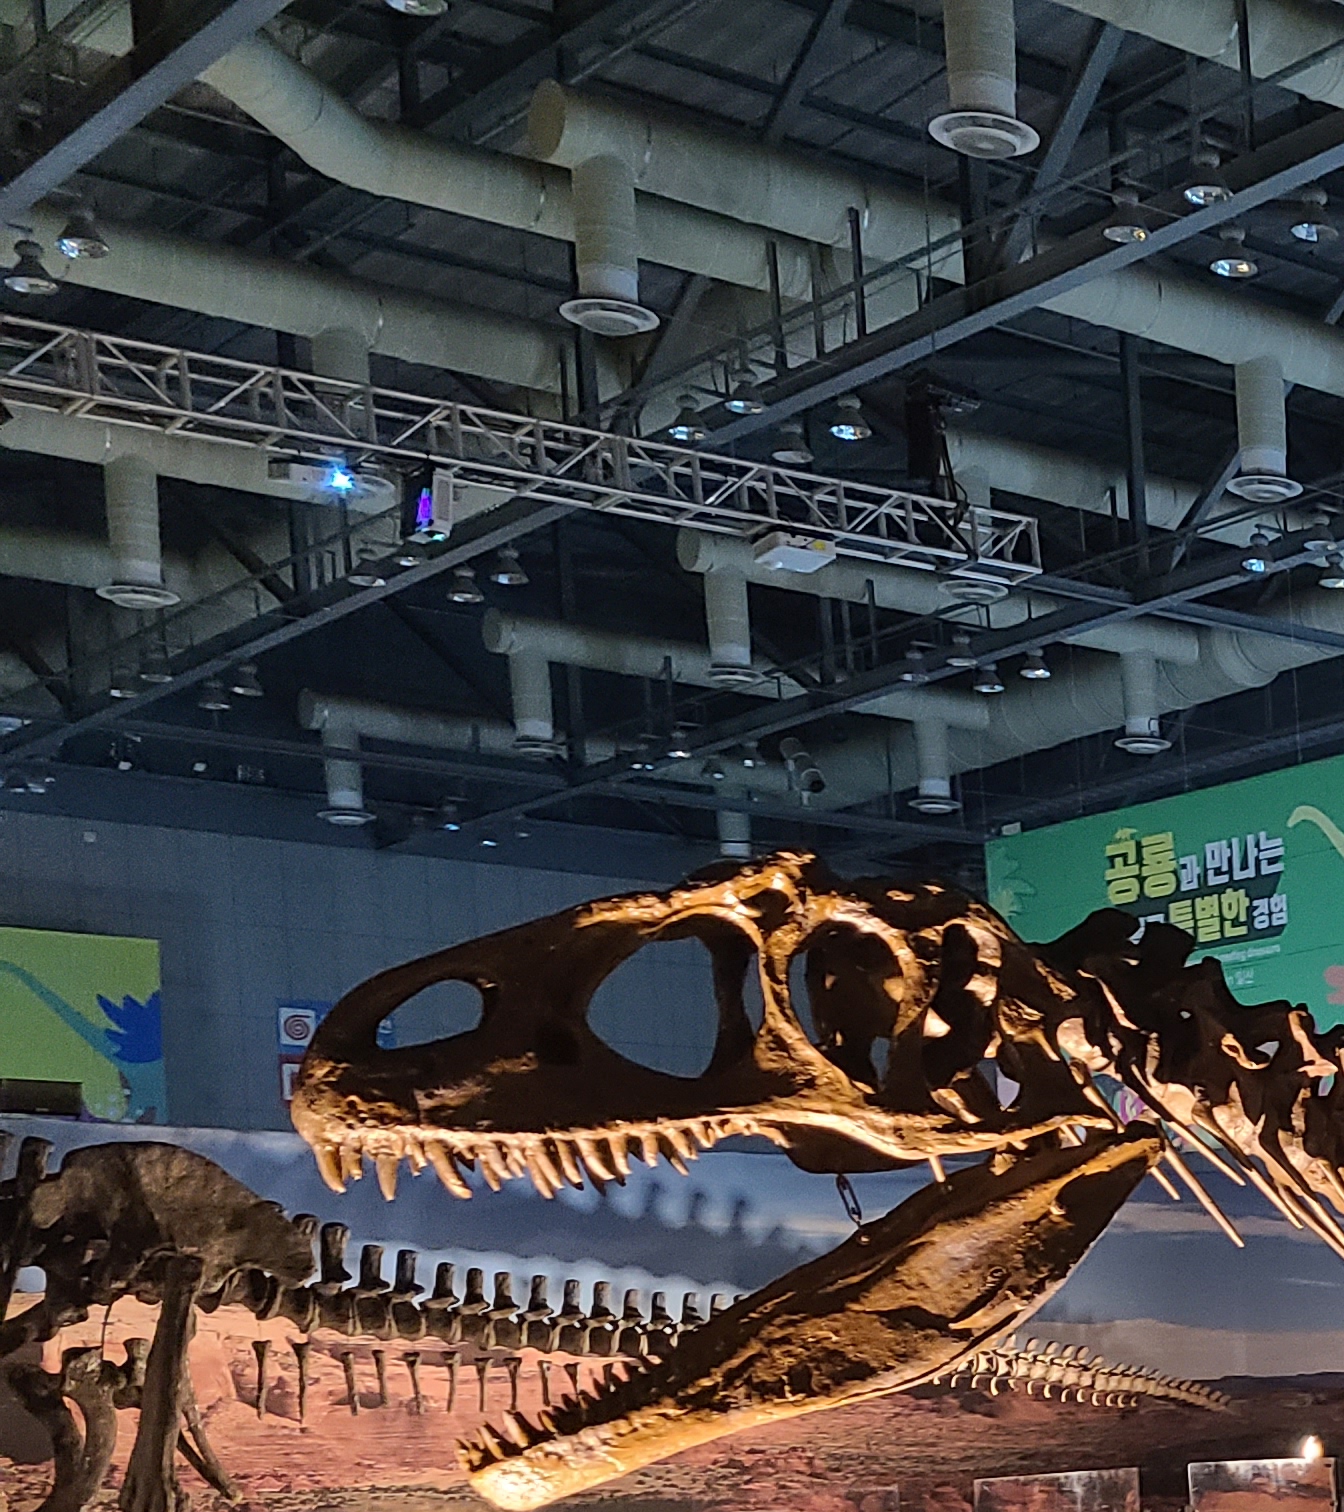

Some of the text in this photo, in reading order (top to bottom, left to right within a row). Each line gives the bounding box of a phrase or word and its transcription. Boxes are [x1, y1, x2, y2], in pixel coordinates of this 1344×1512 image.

[1104, 830, 1285, 905] 공룡과 만나는
[1168, 888, 1250, 943] 특별한
[1252, 893, 1288, 930] 경험
